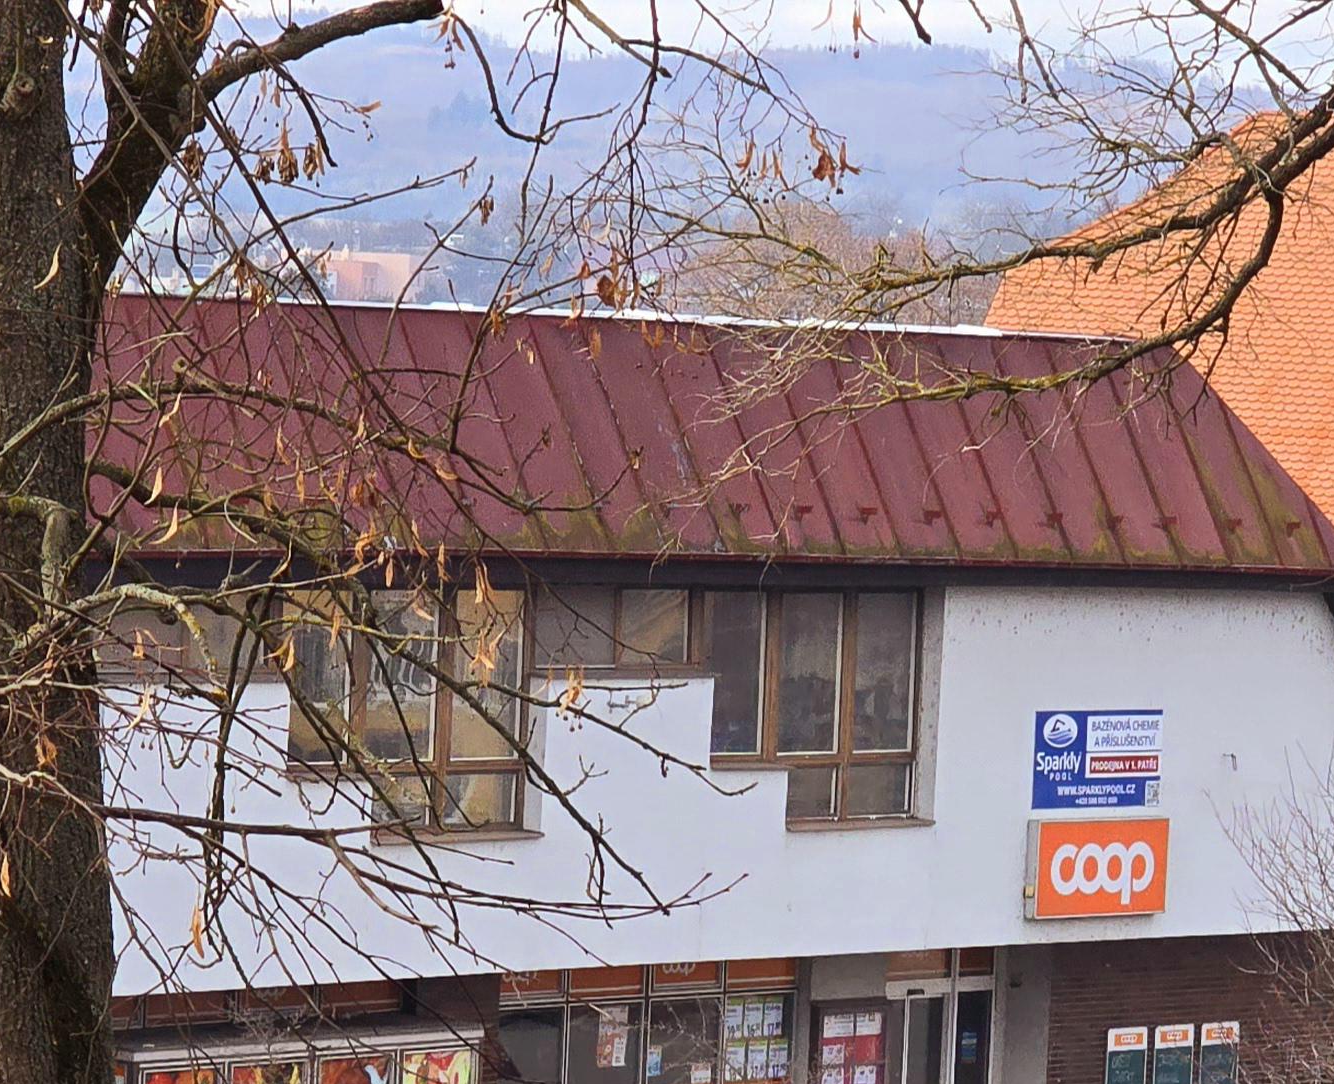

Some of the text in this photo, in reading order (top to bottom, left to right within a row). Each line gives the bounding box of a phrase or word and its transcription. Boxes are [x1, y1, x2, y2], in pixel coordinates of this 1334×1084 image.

[1091, 717, 1160, 731] BAZÉNOVÁ CHEMIE
[1094, 733, 1156, 748] A PŘÍSLUŠENSTVÍ
[1036, 751, 1082, 775] Sparkly
[1049, 772, 1073, 781] POOL
[1057, 783, 1136, 796] WWW.SPARKLYPOOL.CZ
[1050, 842, 1155, 905] coop
